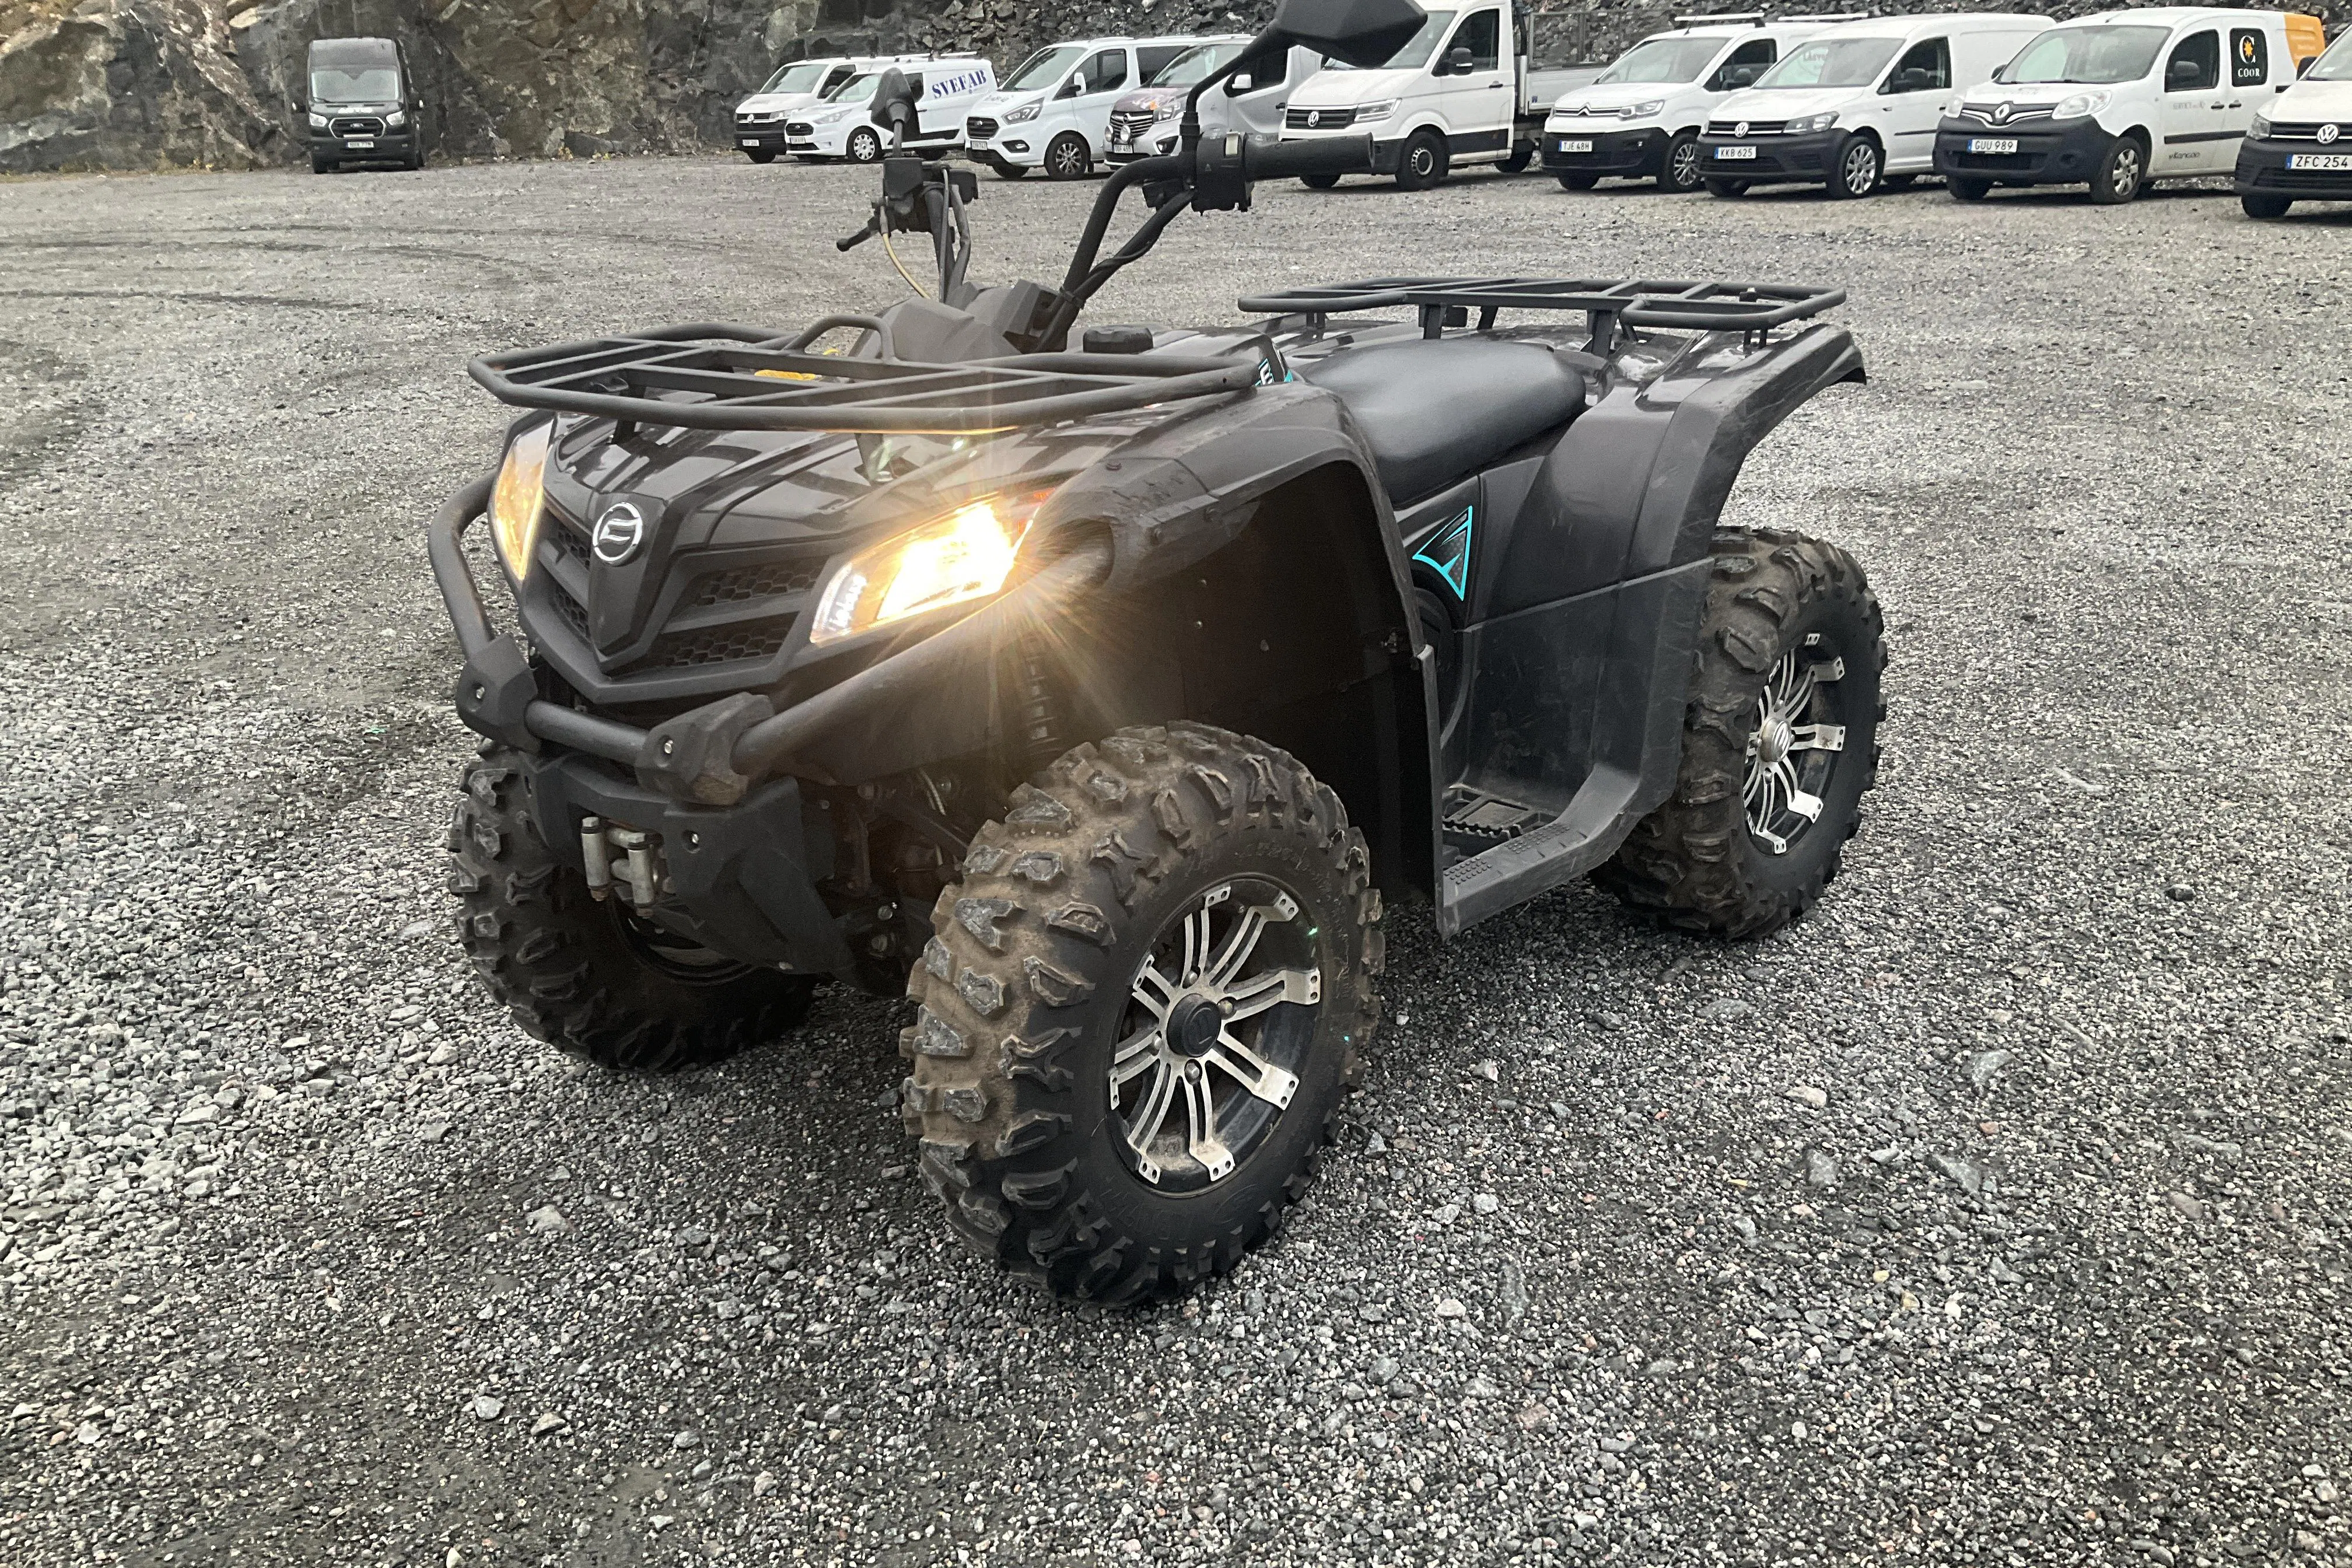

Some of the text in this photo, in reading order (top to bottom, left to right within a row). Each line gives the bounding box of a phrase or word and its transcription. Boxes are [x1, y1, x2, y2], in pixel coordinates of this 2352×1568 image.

[2238, 68, 2260, 78] COOR
[932, 69, 986, 99] SVEFAB
[1564, 142, 1574, 150] TJE
[1975, 141, 2013, 150] GUU 989
[1720, 148, 1752, 158] KKB 625
[2296, 156, 2349, 167] ZFC 254
